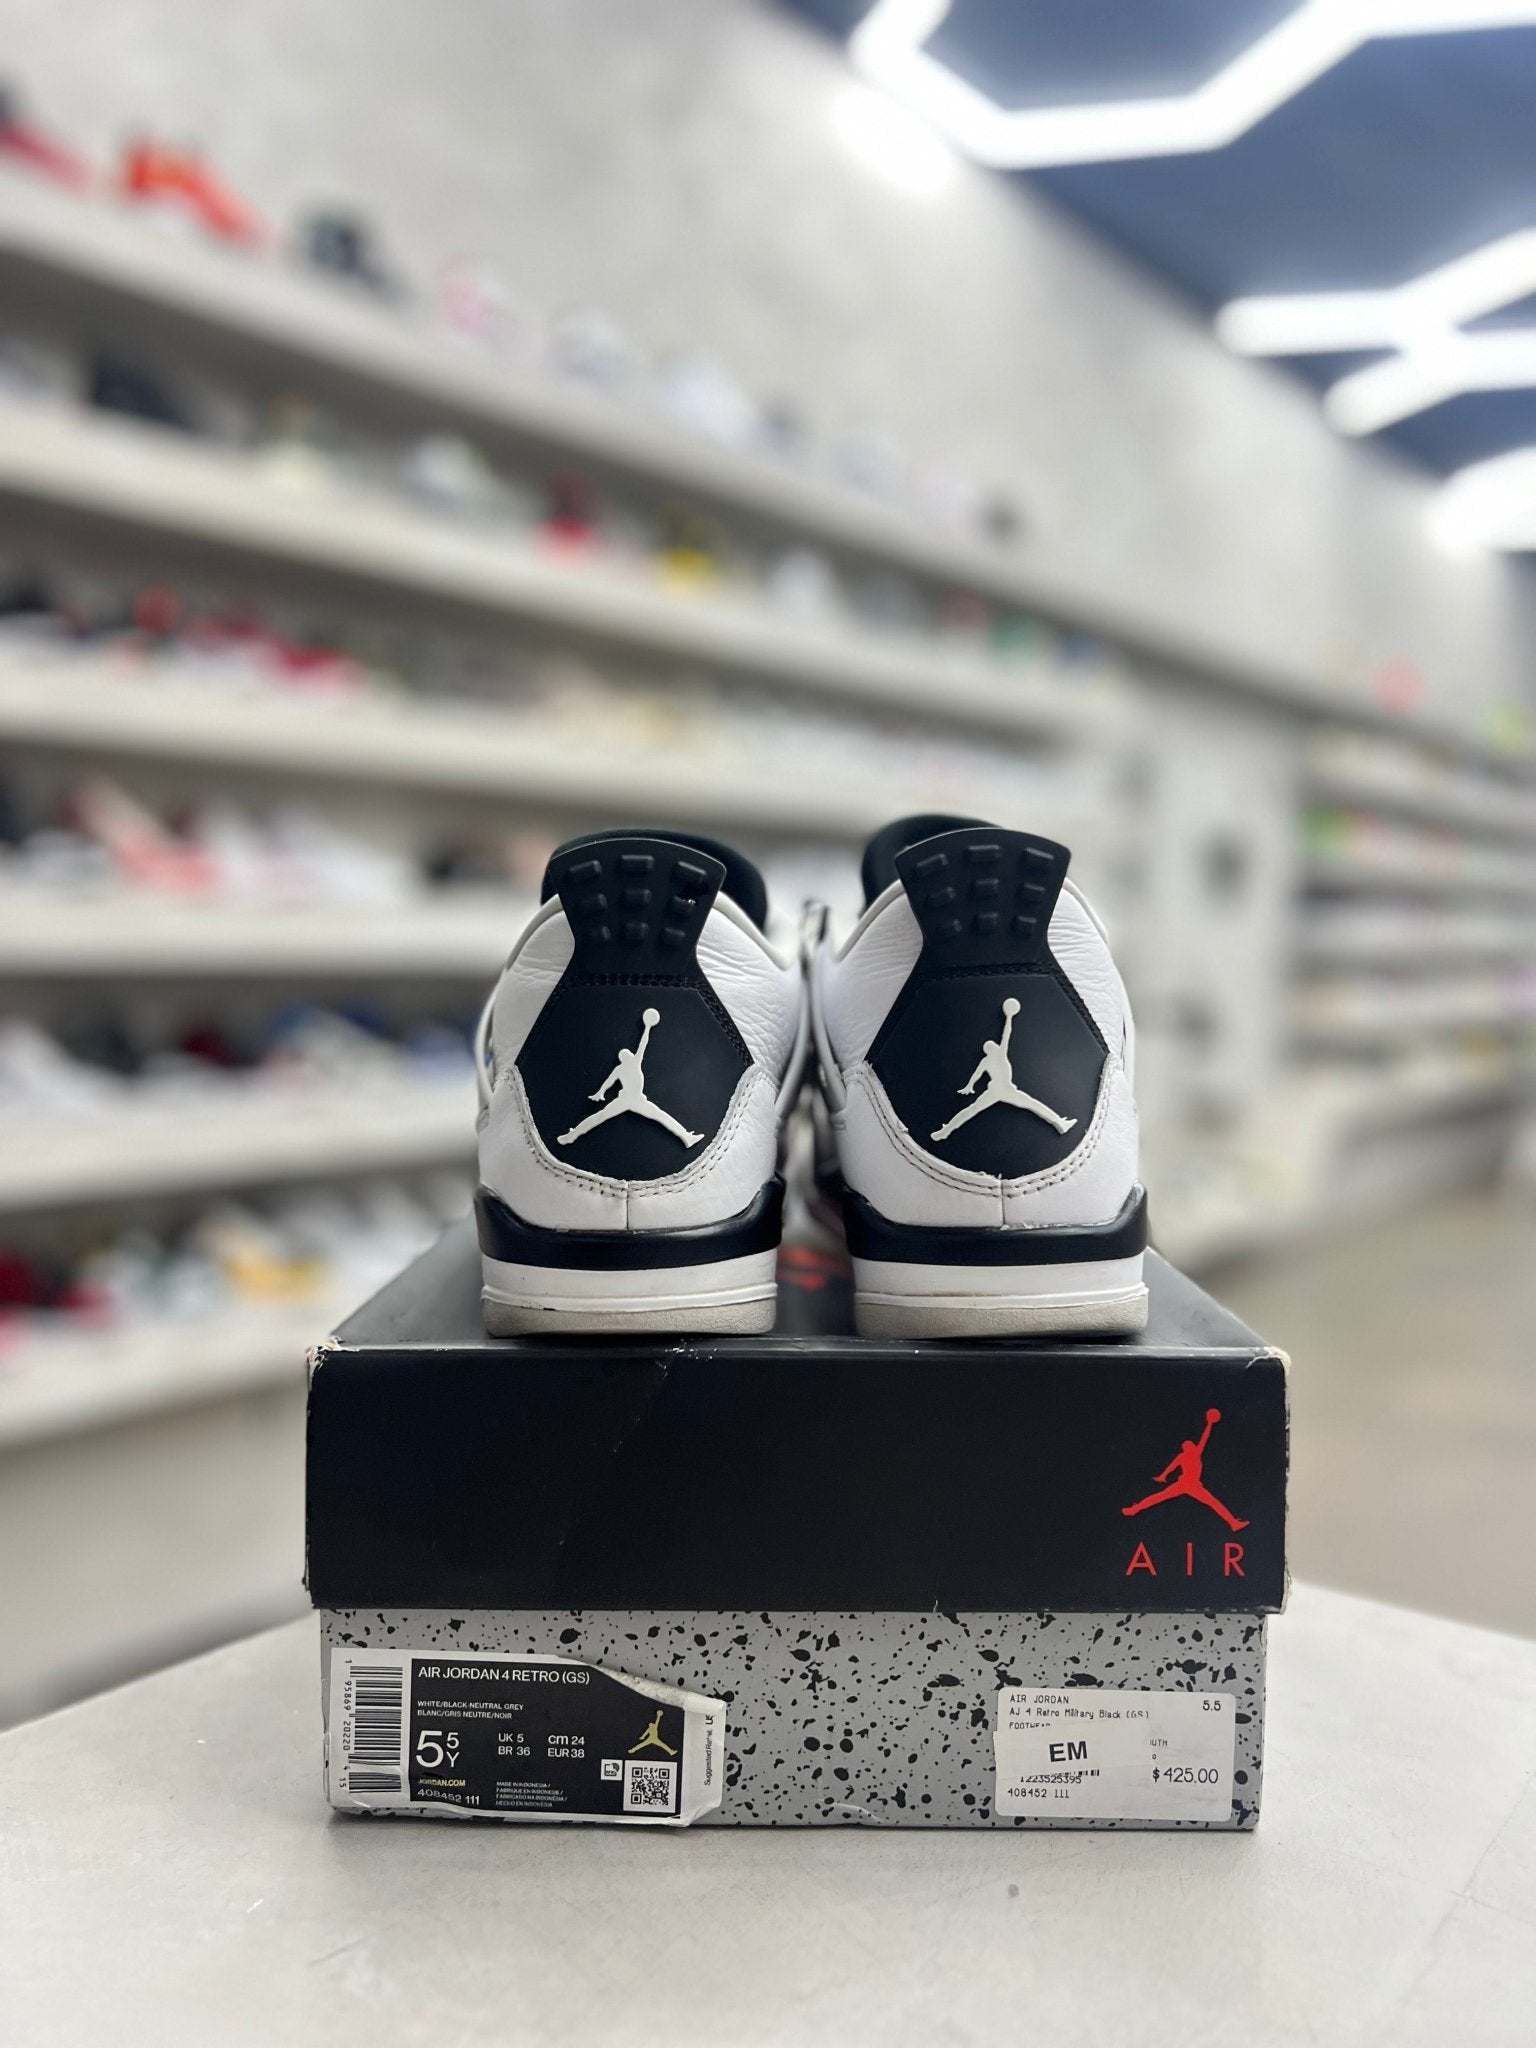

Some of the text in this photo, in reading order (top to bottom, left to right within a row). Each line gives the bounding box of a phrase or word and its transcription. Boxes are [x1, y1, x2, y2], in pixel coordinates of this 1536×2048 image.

[1125, 1541, 1246, 1577] AIR
[418, 1666, 590, 1685] AIR JORDAN 4 RETRO (GS)
[343, 1680, 352, 1711] 95869
[1009, 1694, 1069, 1704] AIR JORDAN
[504, 1703, 524, 1711] GREY
[1202, 1699, 1221, 1712] 5.5
[417, 1710, 512, 1720] BLANC/GRIS NEUTRE/NOIR
[1009, 1707, 1021, 1716] AJ
[1025, 1707, 1031, 1716] 4
[1036, 1708, 1060, 1717] Retro
[1064, 1709, 1094, 1720] Military
[1099, 1710, 1121, 1719] Black
[342, 1720, 351, 1751] 20220
[498, 1733, 524, 1743] UK 5
[548, 1735, 585, 1746] cm 24
[415, 1730, 460, 1768] 5 5
[497, 1746, 530, 1756] BR 36
[547, 1748, 585, 1758] EUR 38
[1048, 1740, 1088, 1763] EM
[446, 1751, 460, 1768] Y
[1152, 1767, 1219, 1784] $425.00
[417, 1778, 466, 1787] JORDAN.COM
[417, 1788, 480, 1806] 408452 111
[1008, 1787, 1069, 1799] 408452 111
